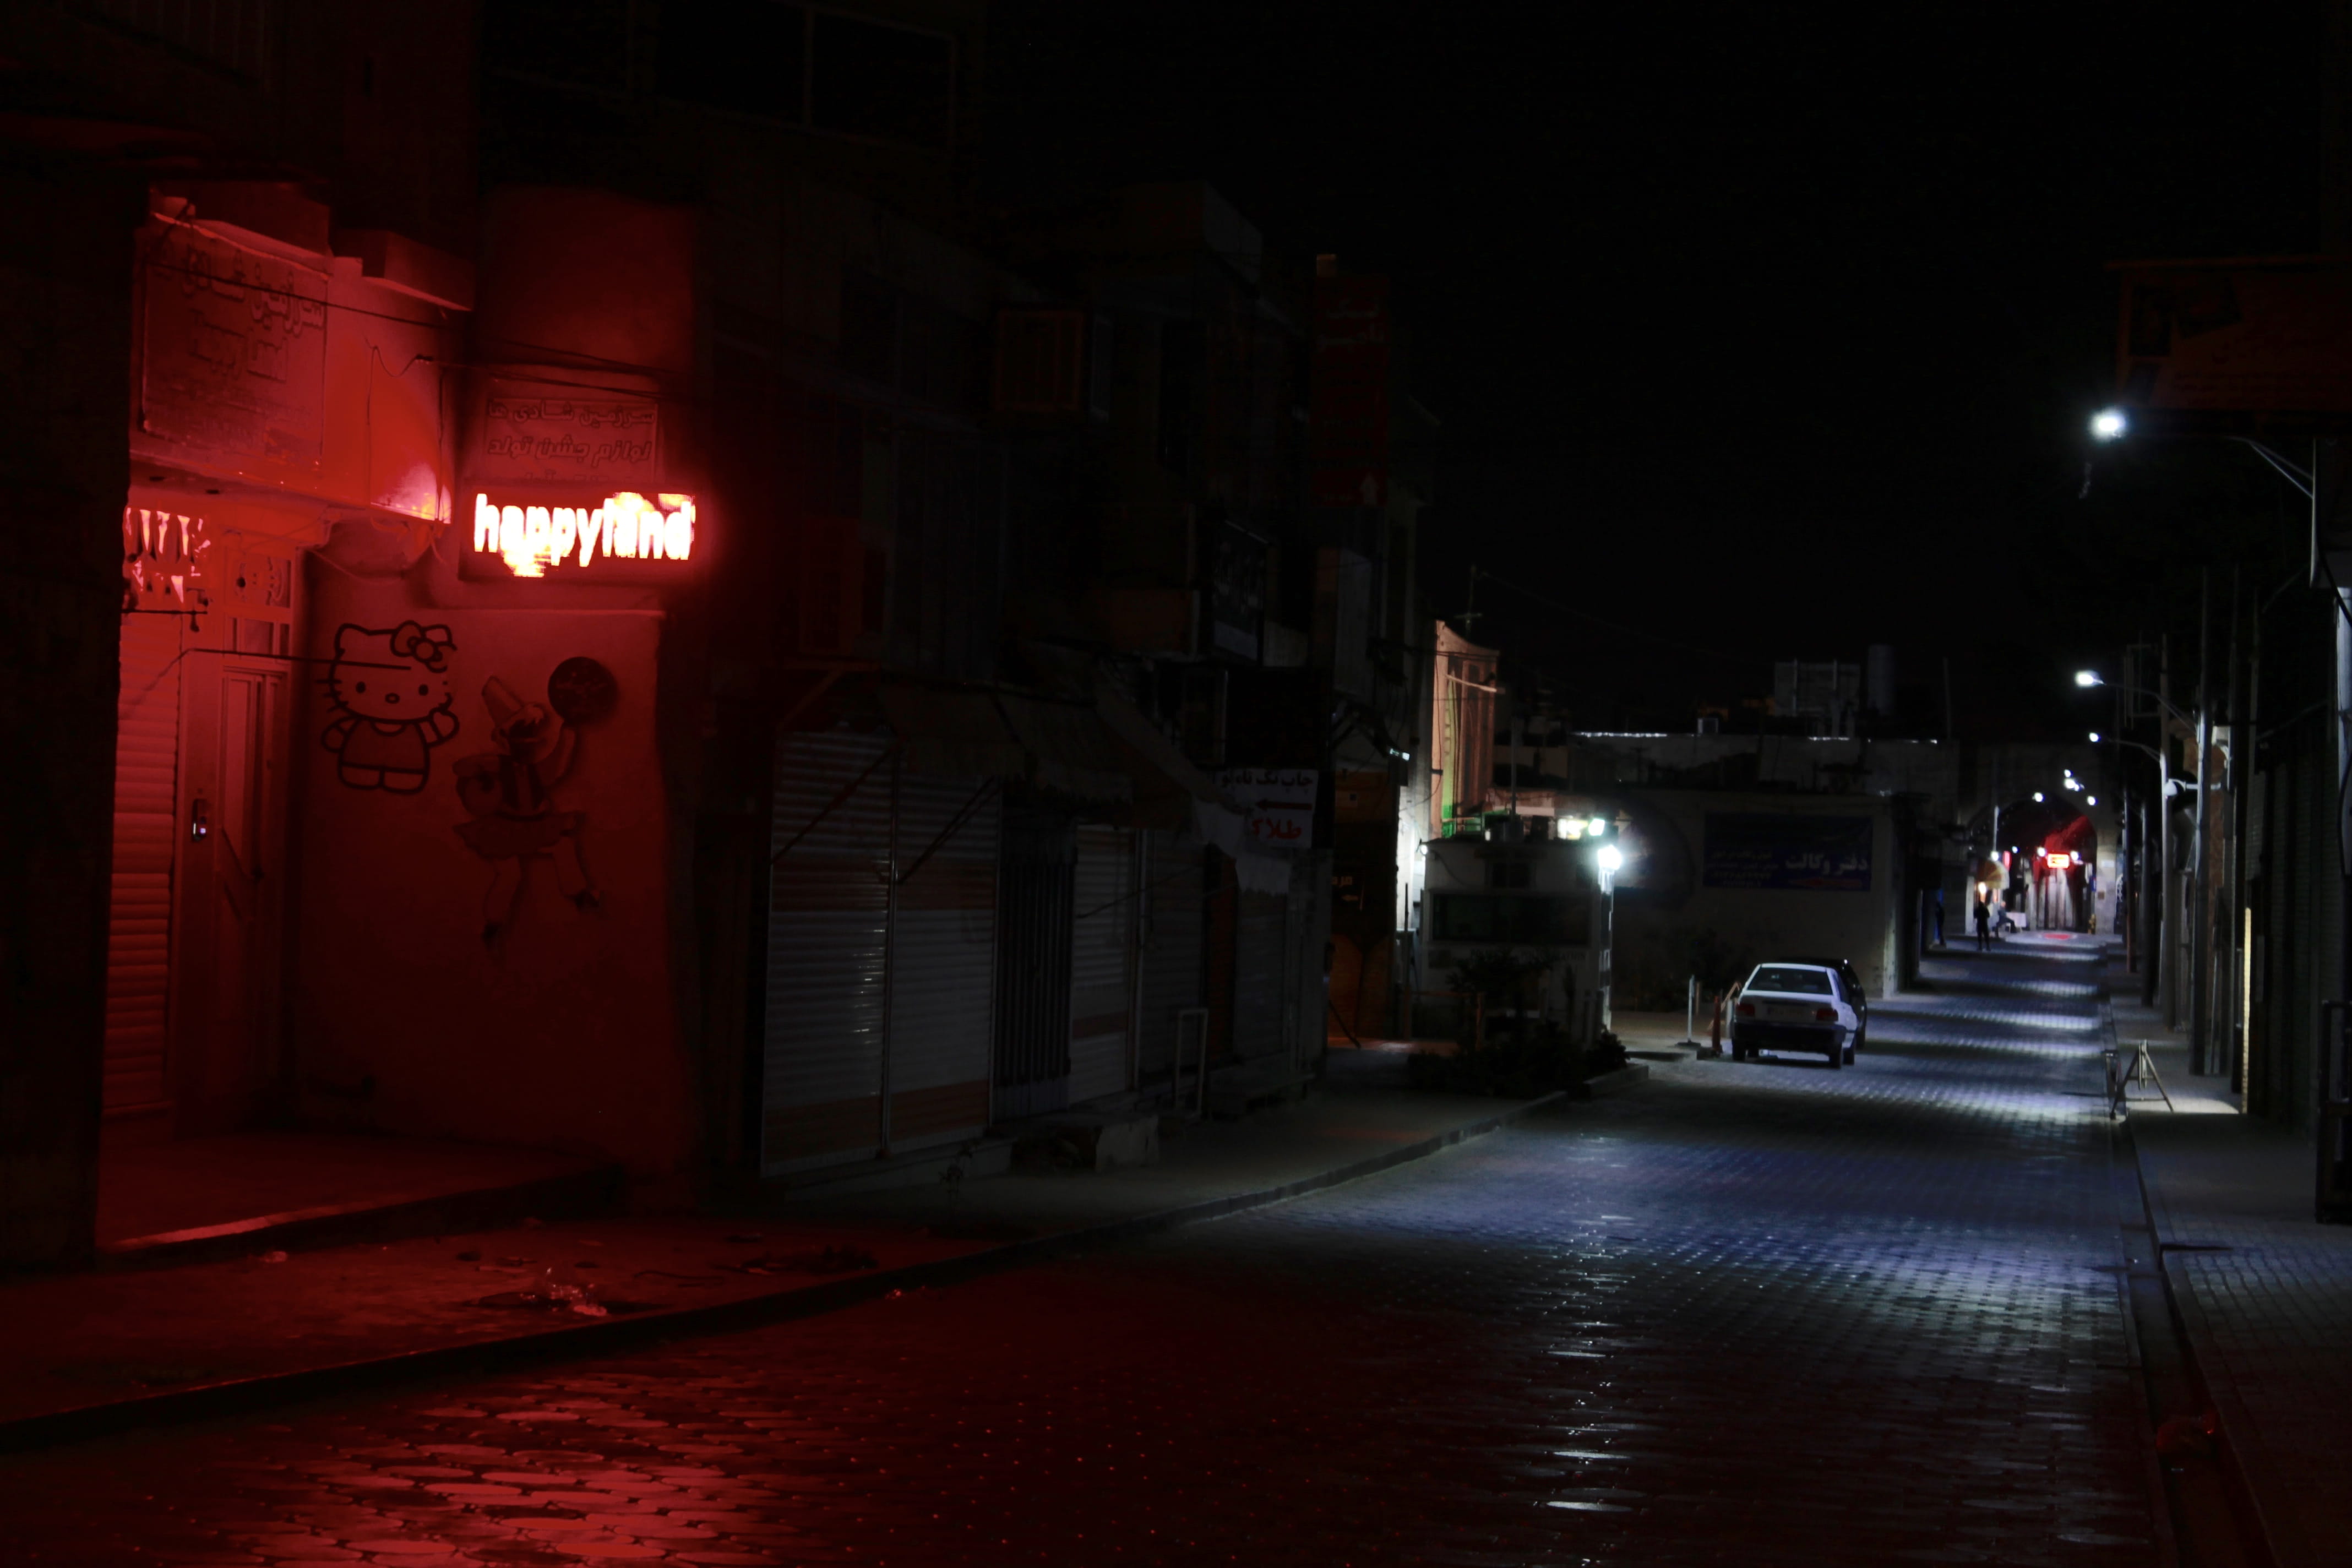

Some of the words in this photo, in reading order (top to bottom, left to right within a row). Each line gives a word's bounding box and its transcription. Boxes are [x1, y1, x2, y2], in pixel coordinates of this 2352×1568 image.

[487, 399, 508, 418] ها
[513, 398, 575, 423] شادی
[579, 405, 656, 428] سرزمین
[488, 435, 534, 460] تولد
[535, 433, 591, 463] جشن
[592, 439, 653, 467] لوازم
[473, 492, 695, 568] happyland
[1281, 770, 1313, 794] چاپ
[1785, 852, 1831, 875] وکالت
[1833, 847, 1868, 876] دفتر
